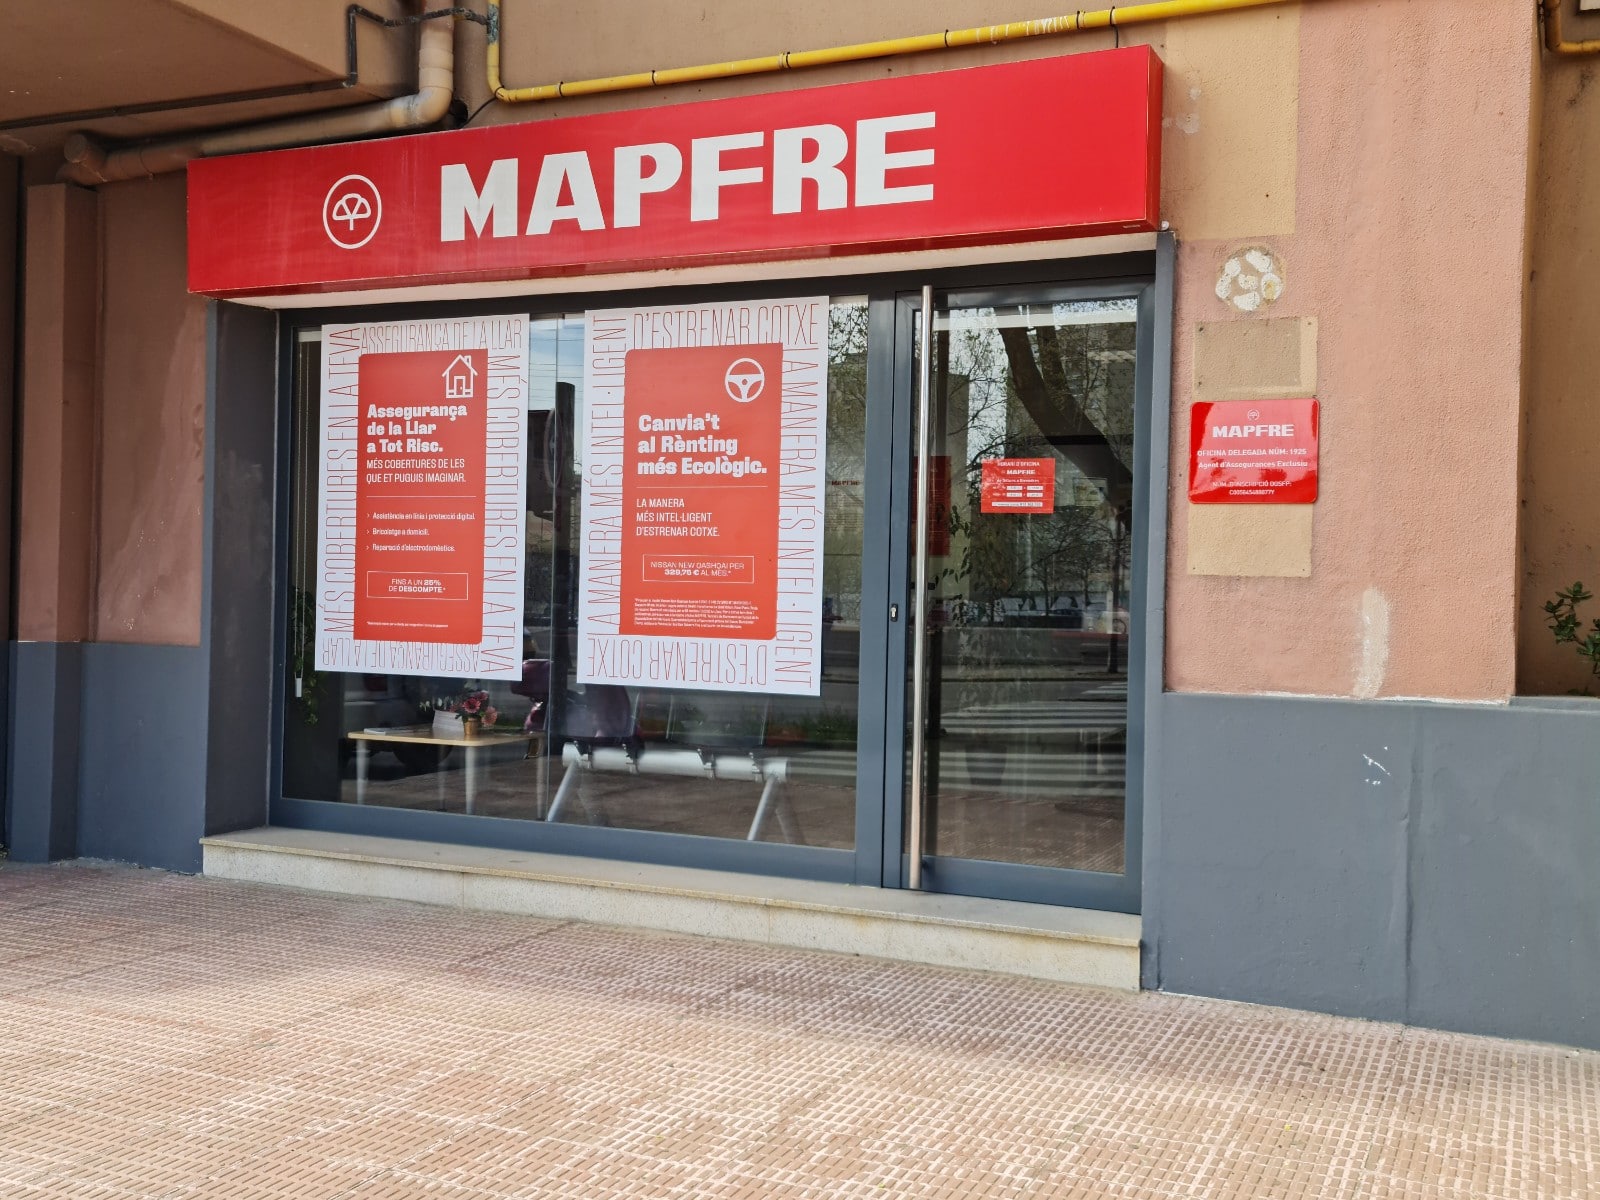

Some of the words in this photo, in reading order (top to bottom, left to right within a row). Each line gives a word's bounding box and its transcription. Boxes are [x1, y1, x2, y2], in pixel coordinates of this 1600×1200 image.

[441, 112, 936, 242] MAPFRE
[361, 323, 449, 353] ASSEGURANÇA
[453, 321, 469, 350] DE
[491, 319, 522, 350] LLAR
[634, 307, 750, 350] D'ESTRENAR
[758, 303, 819, 345] COTXE
[329, 328, 360, 379] TEVA
[487, 355, 527, 399] MÉS
[367, 404, 467, 421] Assegurança
[639, 413, 720, 432] Canvia't
[367, 422, 385, 435] de
[389, 421, 402, 435] la
[406, 420, 436, 435] Llar
[779, 381, 818, 476] MANERA
[1212, 424, 1294, 438] MAPFRE
[367, 442, 376, 453] a
[379, 438, 403, 453] Tot
[407, 438, 443, 453] Risc.
[638, 436, 655, 453] al
[661, 434, 738, 456] Rènting
[1269, 447, 1288, 455] NÚM:
[367, 457, 383, 469] MÉS
[385, 459, 436, 469] COBERTURES
[438, 459, 448, 468] DE
[451, 458, 464, 468] LES
[484, 407, 519, 547] COBERTURES
[637, 457, 677, 475] més
[682, 456, 767, 477] Ecològic.
[1220, 461, 1275, 469] d'Assegurances
[367, 473, 381, 484] QUE
[384, 473, 393, 482] ET
[395, 473, 423, 482] PUGUIS
[426, 472, 466, 482] IMAGINAR.
[584, 464, 623, 506] MÉS
[325, 449, 358, 583] COBERTURES
[636, 498, 647, 508] LA
[649, 498, 684, 508] MANERA
[636, 510, 654, 522] MÉS
[778, 485, 822, 530] MÉS
[636, 526, 688, 536] D'ESTRENAR
[690, 526, 720, 536] COTXE.
[588, 515, 622, 603] MANERA
[729, 562, 744, 570] PER
[319, 590, 354, 632] MÉS
[322, 637, 350, 666] LLAR
[480, 622, 515, 672] TEVA
[587, 638, 642, 679] COTXE
[650, 640, 767, 685] D'ESTRENAR
